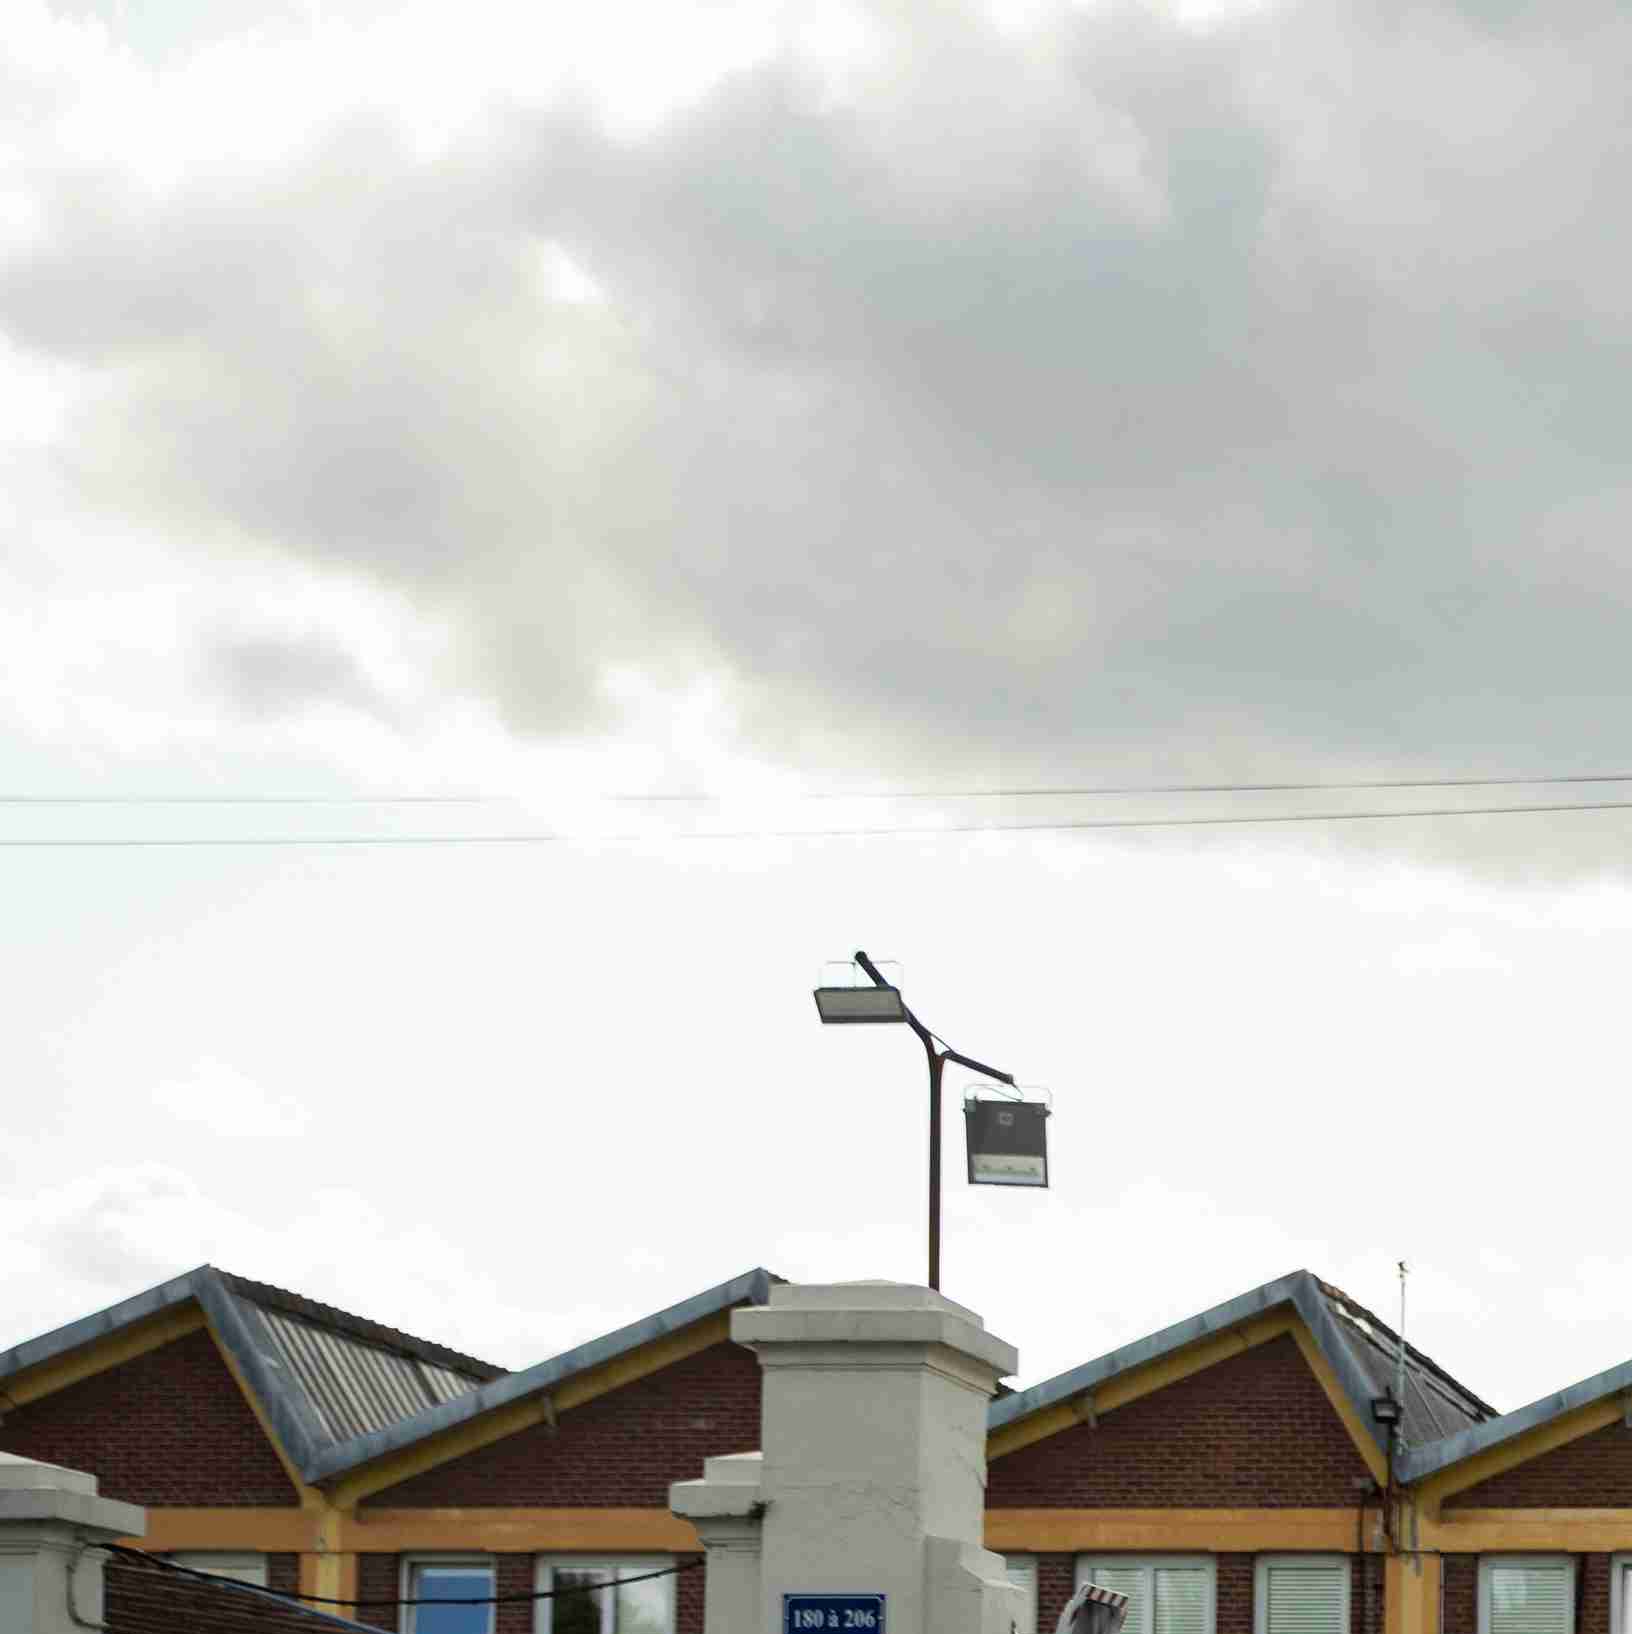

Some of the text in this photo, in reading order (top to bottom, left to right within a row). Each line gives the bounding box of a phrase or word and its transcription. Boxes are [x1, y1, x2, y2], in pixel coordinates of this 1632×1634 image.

[793, 1608, 876, 1628] 180 à 206
